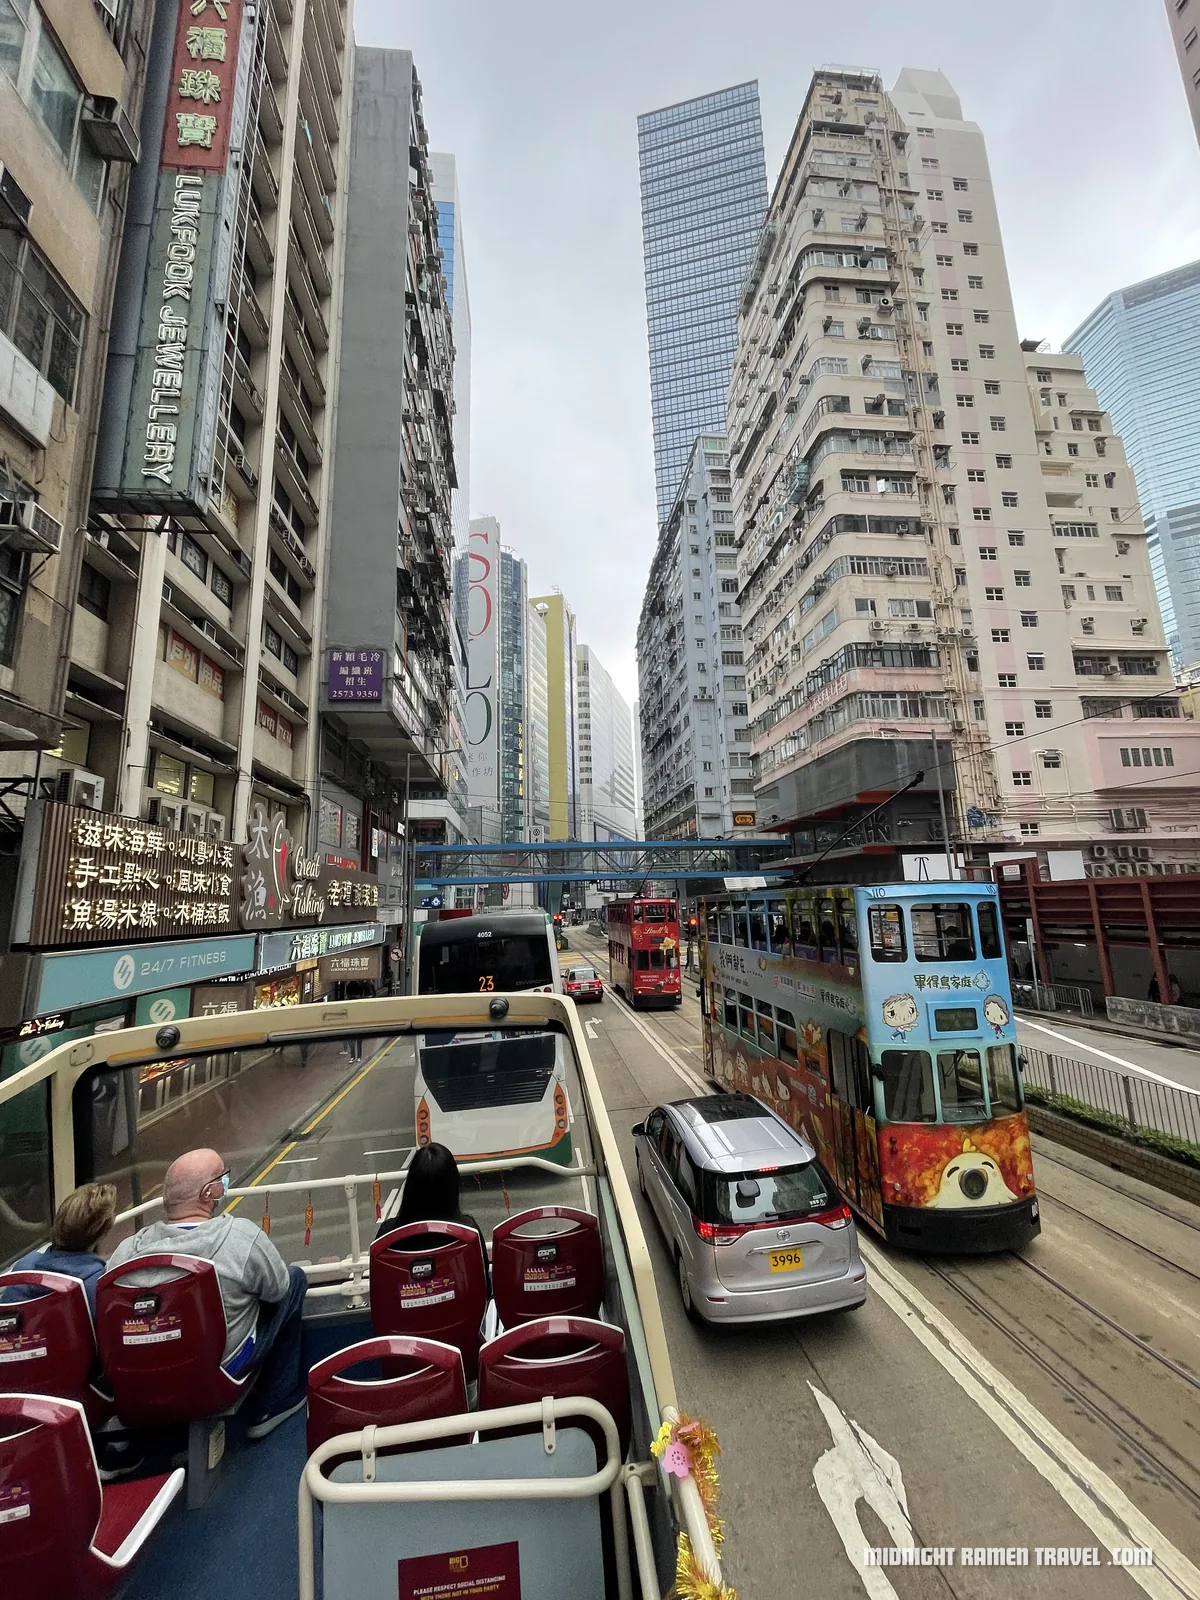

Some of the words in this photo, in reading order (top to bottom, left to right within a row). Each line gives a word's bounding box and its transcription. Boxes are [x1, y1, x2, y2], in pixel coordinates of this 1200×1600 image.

[163, 174, 202, 300] LUKFOOK
[141, 305, 188, 486] JEWELLERY
[345, 677, 367, 686] 招生
[332, 690, 354, 698] 2573
[356, 690, 378, 698] 9350
[77, 819, 166, 858] 滋味海鮮
[179, 837, 234, 868] 川粵小菜
[295, 845, 321, 878] Great
[74, 857, 160, 892] 手工點心
[177, 869, 233, 896] 風味小食
[293, 884, 325, 922] Fishing
[872, 888, 886, 899] 110
[70, 898, 158, 930] 魚湯米線
[174, 900, 230, 926] 木桶蒸飯
[141, 958, 175, 976] 24/7
[179, 951, 227, 969] FITNESS
[330, 957, 370, 968] 六福珠寶
[478, 975, 495, 992] 23
[202, 1001, 239, 1017] 六福
[771, 1253, 801, 1268] 3996
[413, 1587, 433, 1596] PLEASE
[433, 1583, 457, 1593] RESPECT
[457, 1580, 475, 1588] SOCIAL
[475, 1575, 506, 1585] DISTANCING
[483, 1584, 500, 1592] PARTY
